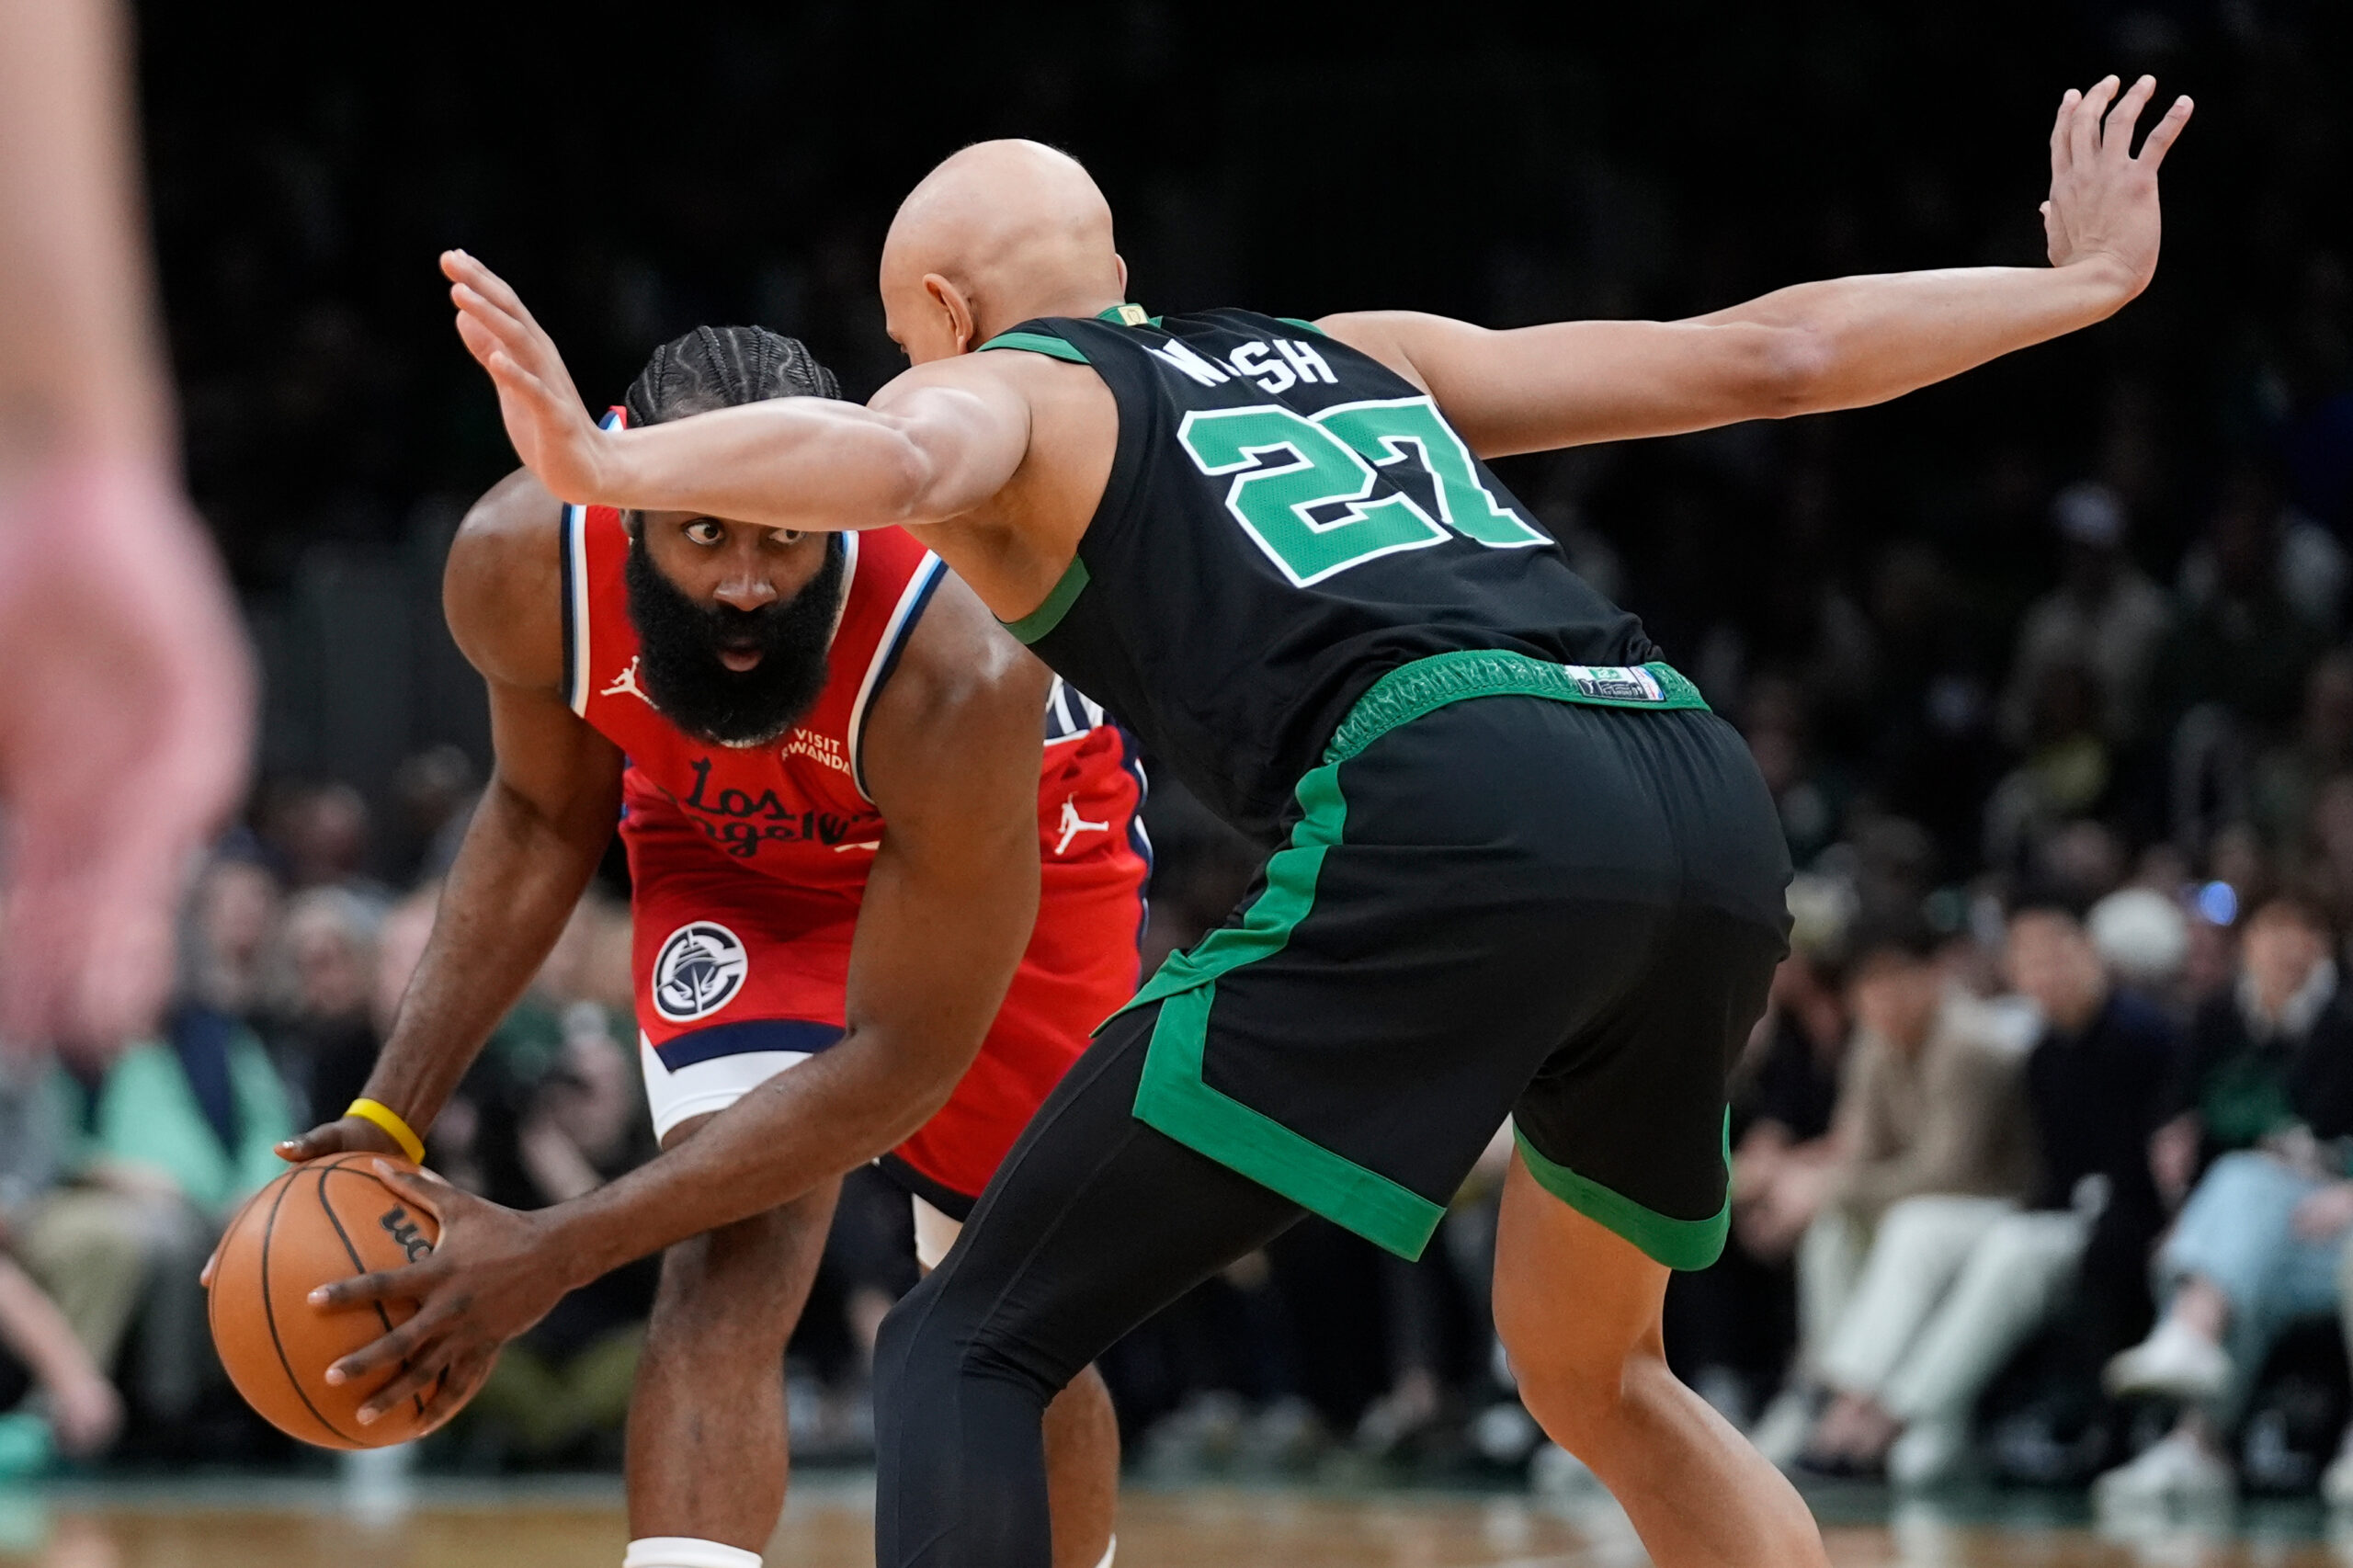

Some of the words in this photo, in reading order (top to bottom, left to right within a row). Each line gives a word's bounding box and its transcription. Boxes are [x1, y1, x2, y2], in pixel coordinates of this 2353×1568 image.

[1176, 395, 1554, 588] 27
[793, 728, 840, 754] VISIT
[685, 756, 797, 821] Los
